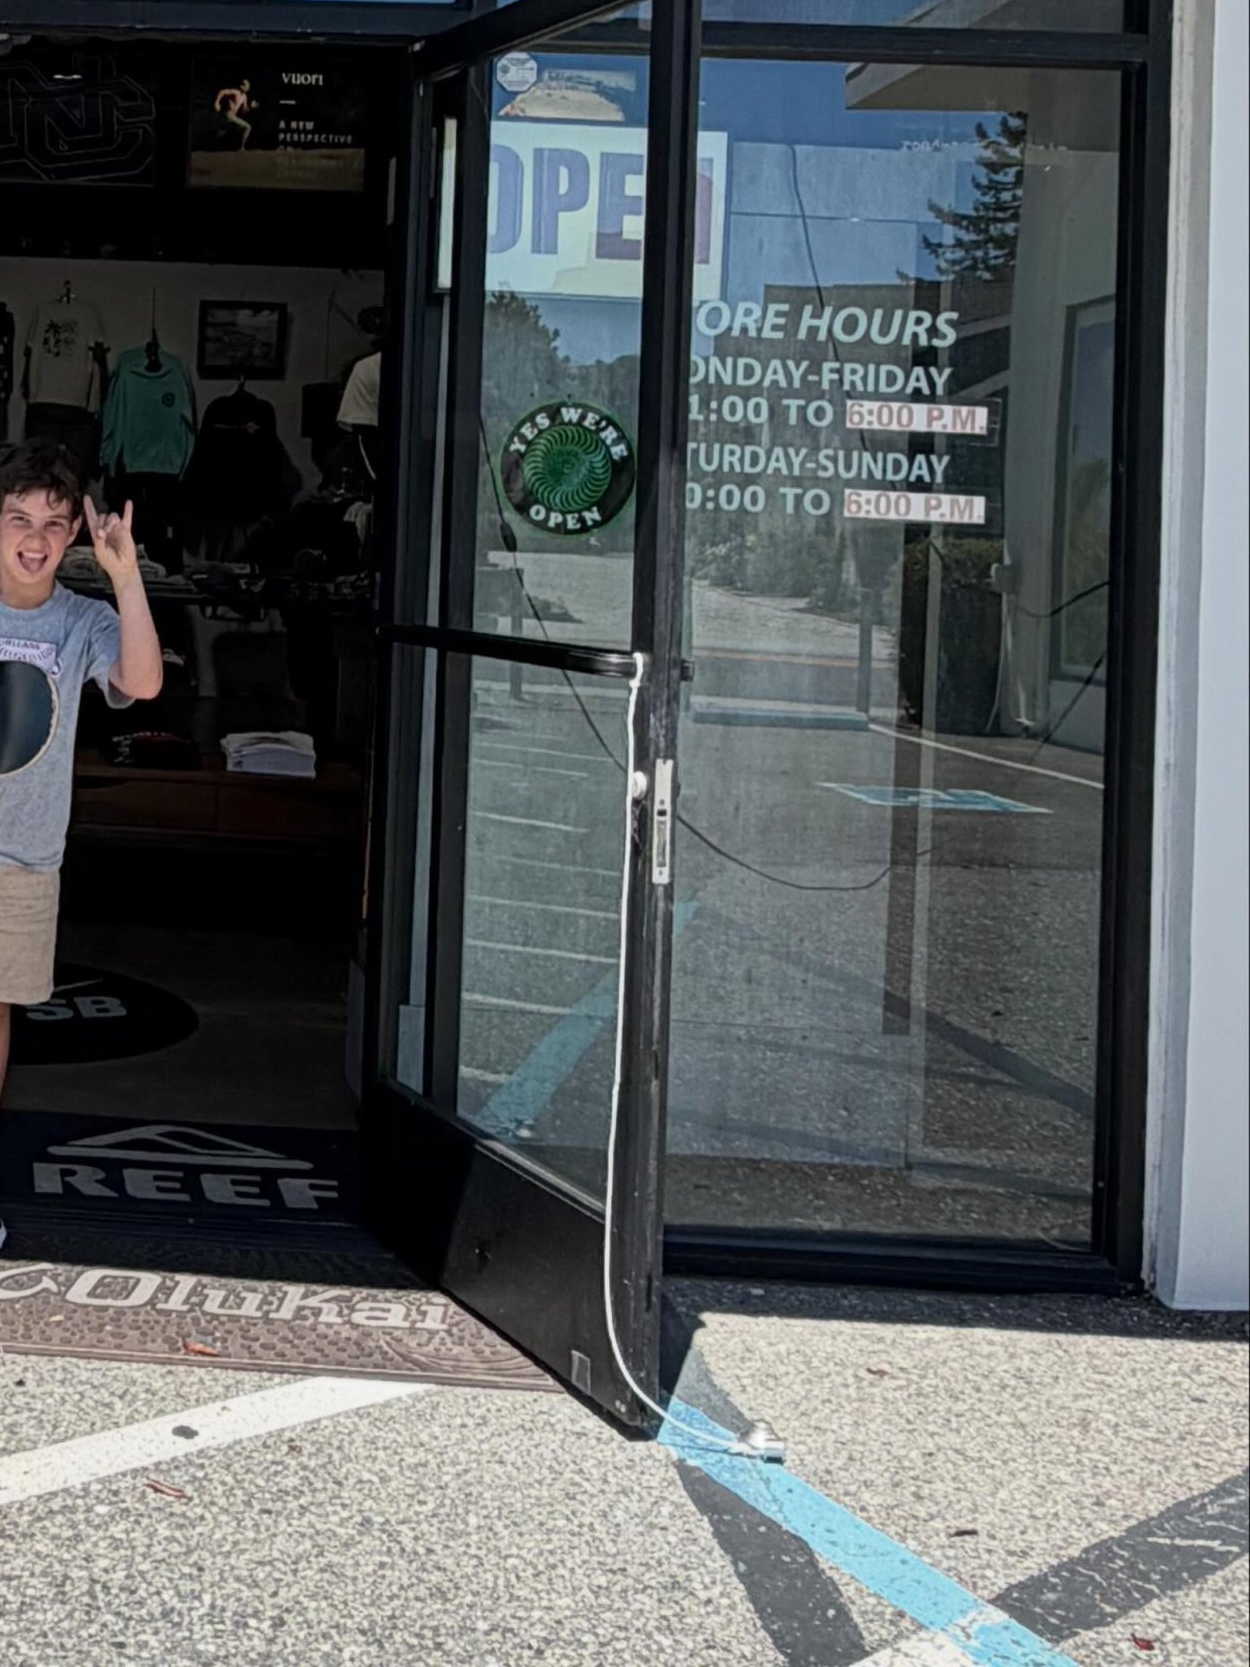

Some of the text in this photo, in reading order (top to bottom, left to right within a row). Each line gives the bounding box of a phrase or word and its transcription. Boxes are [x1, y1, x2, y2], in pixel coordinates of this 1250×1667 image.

[281, 71, 324, 86] vuori
[488, 142, 714, 265] OPE
[695, 300, 960, 348] ORE HOURS
[689, 354, 954, 396] ONDAY-FRIDAY
[508, 406, 629, 461] YES WE'RE
[688, 394, 986, 433] 1:00 TO 6:00 P.M.
[687, 441, 951, 484] TURDAY-SUNDAY
[528, 504, 602, 530] OPEN
[685, 481, 984, 521] 0:00 TO 6:00 P.M.
[31, 1160, 339, 1210] REEF
[63, 1267, 453, 1331] OluKai
